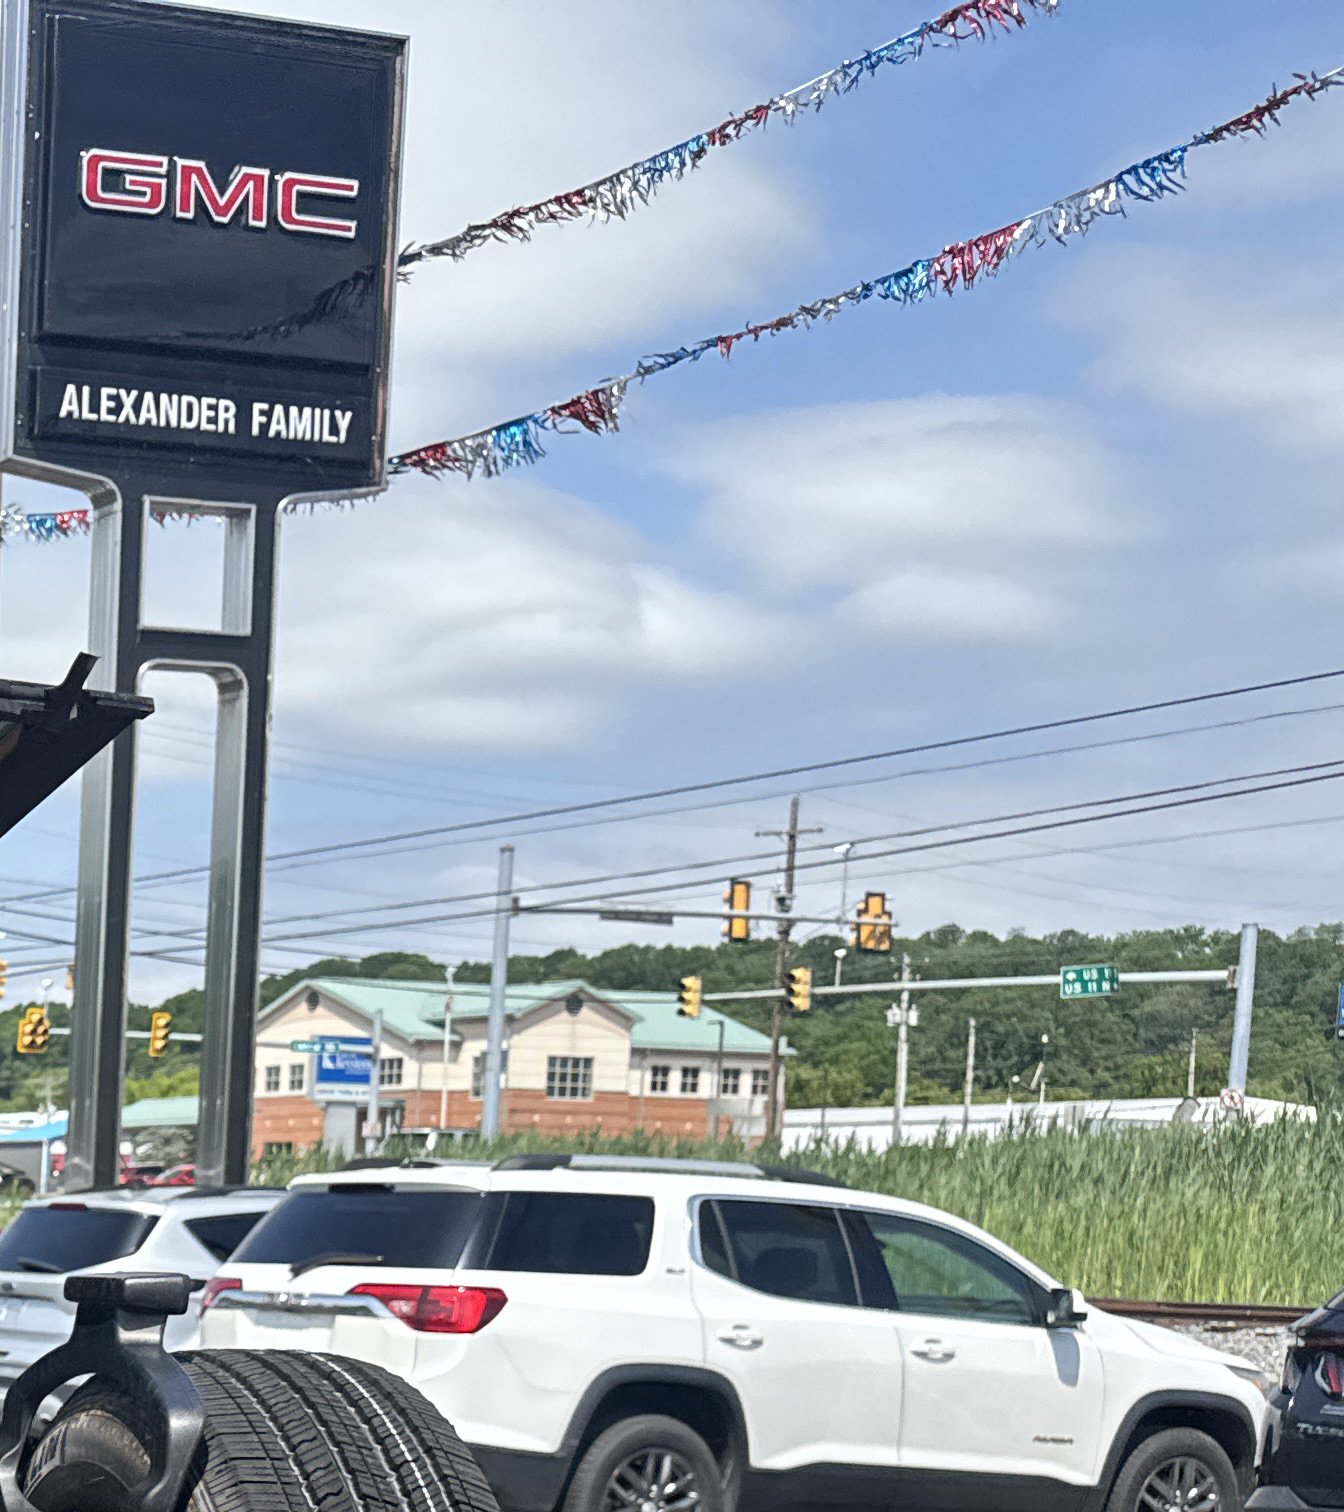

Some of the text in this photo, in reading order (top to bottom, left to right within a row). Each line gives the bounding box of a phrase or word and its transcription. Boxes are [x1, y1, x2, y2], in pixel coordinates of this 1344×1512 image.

[80, 147, 360, 239] GMC
[59, 383, 354, 445] ALEXANDER FAMILY
[1064, 981, 1082, 995] US
[1087, 981, 1098, 993] 11
[1082, 967, 1099, 981] US
